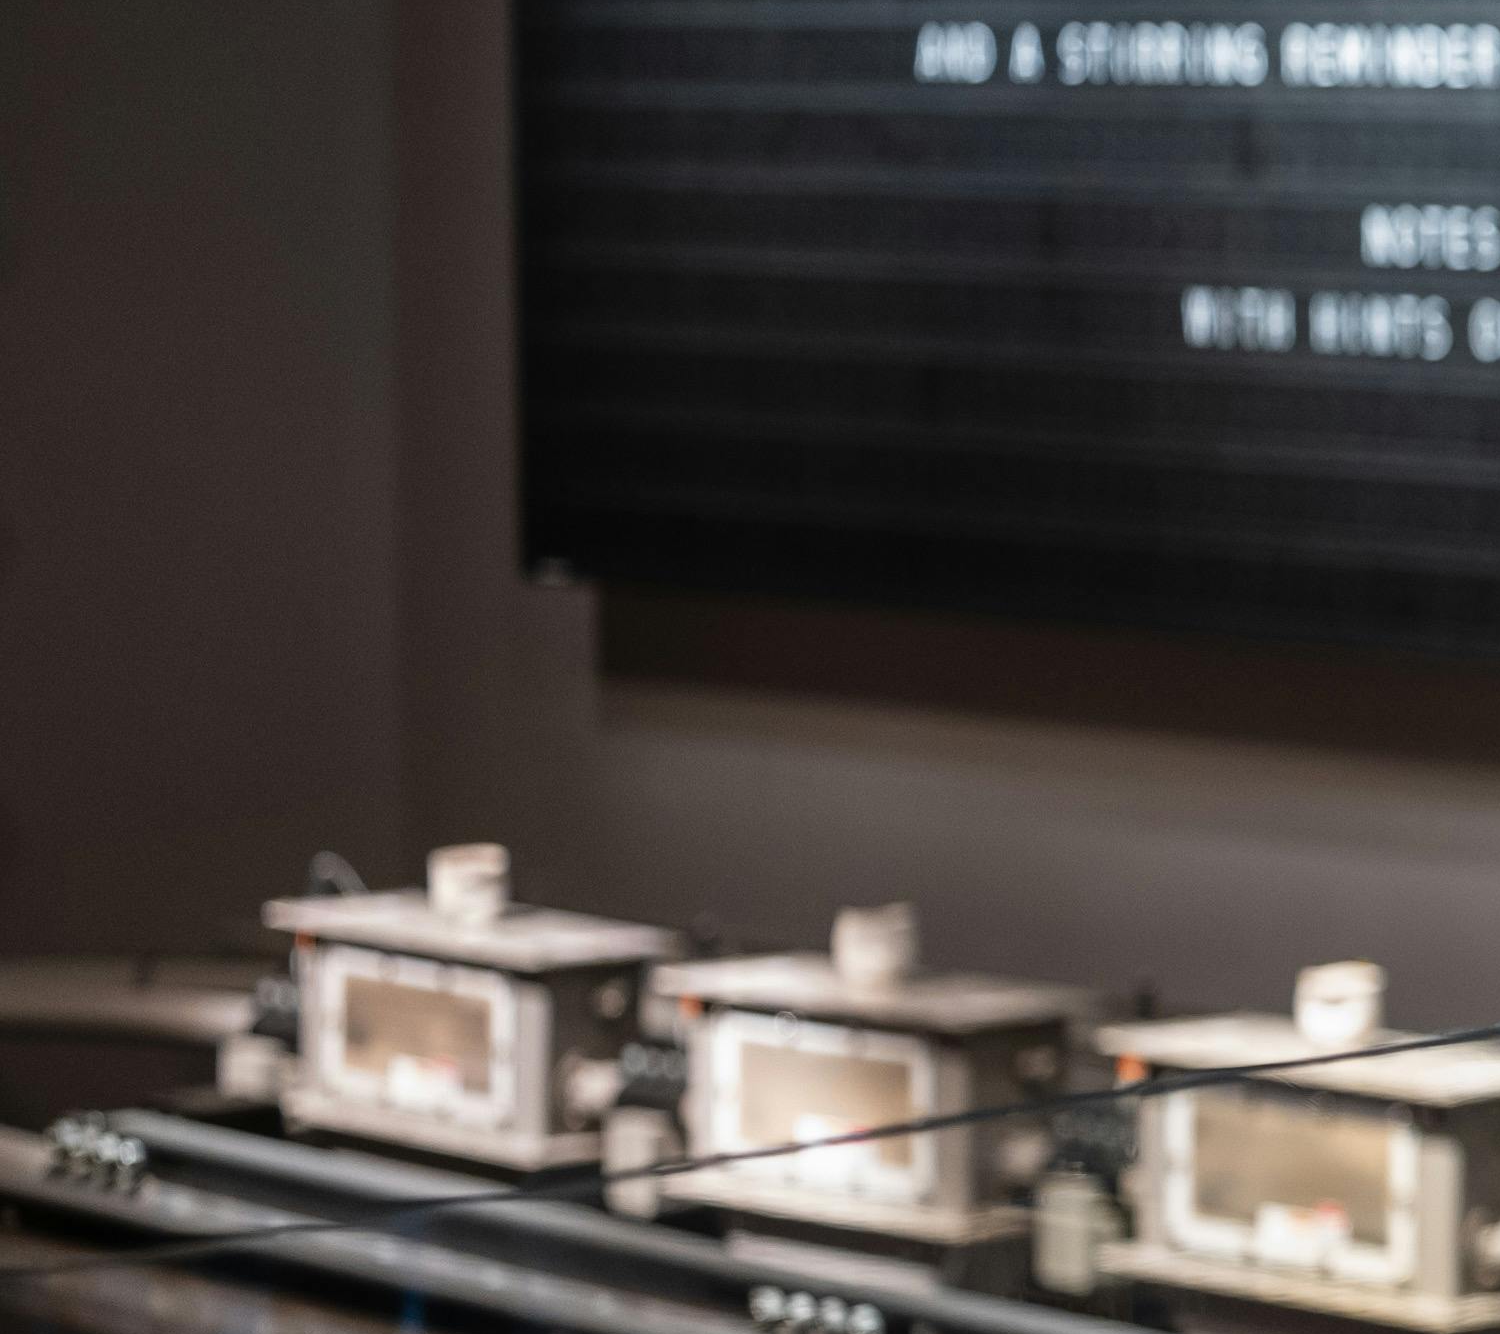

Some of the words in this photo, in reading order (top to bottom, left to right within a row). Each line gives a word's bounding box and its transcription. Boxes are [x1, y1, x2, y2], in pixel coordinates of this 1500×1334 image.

[916, 22, 995, 83] AND
[1009, 23, 1044, 81] A
[1310, 294, 1451, 360] HINTS
